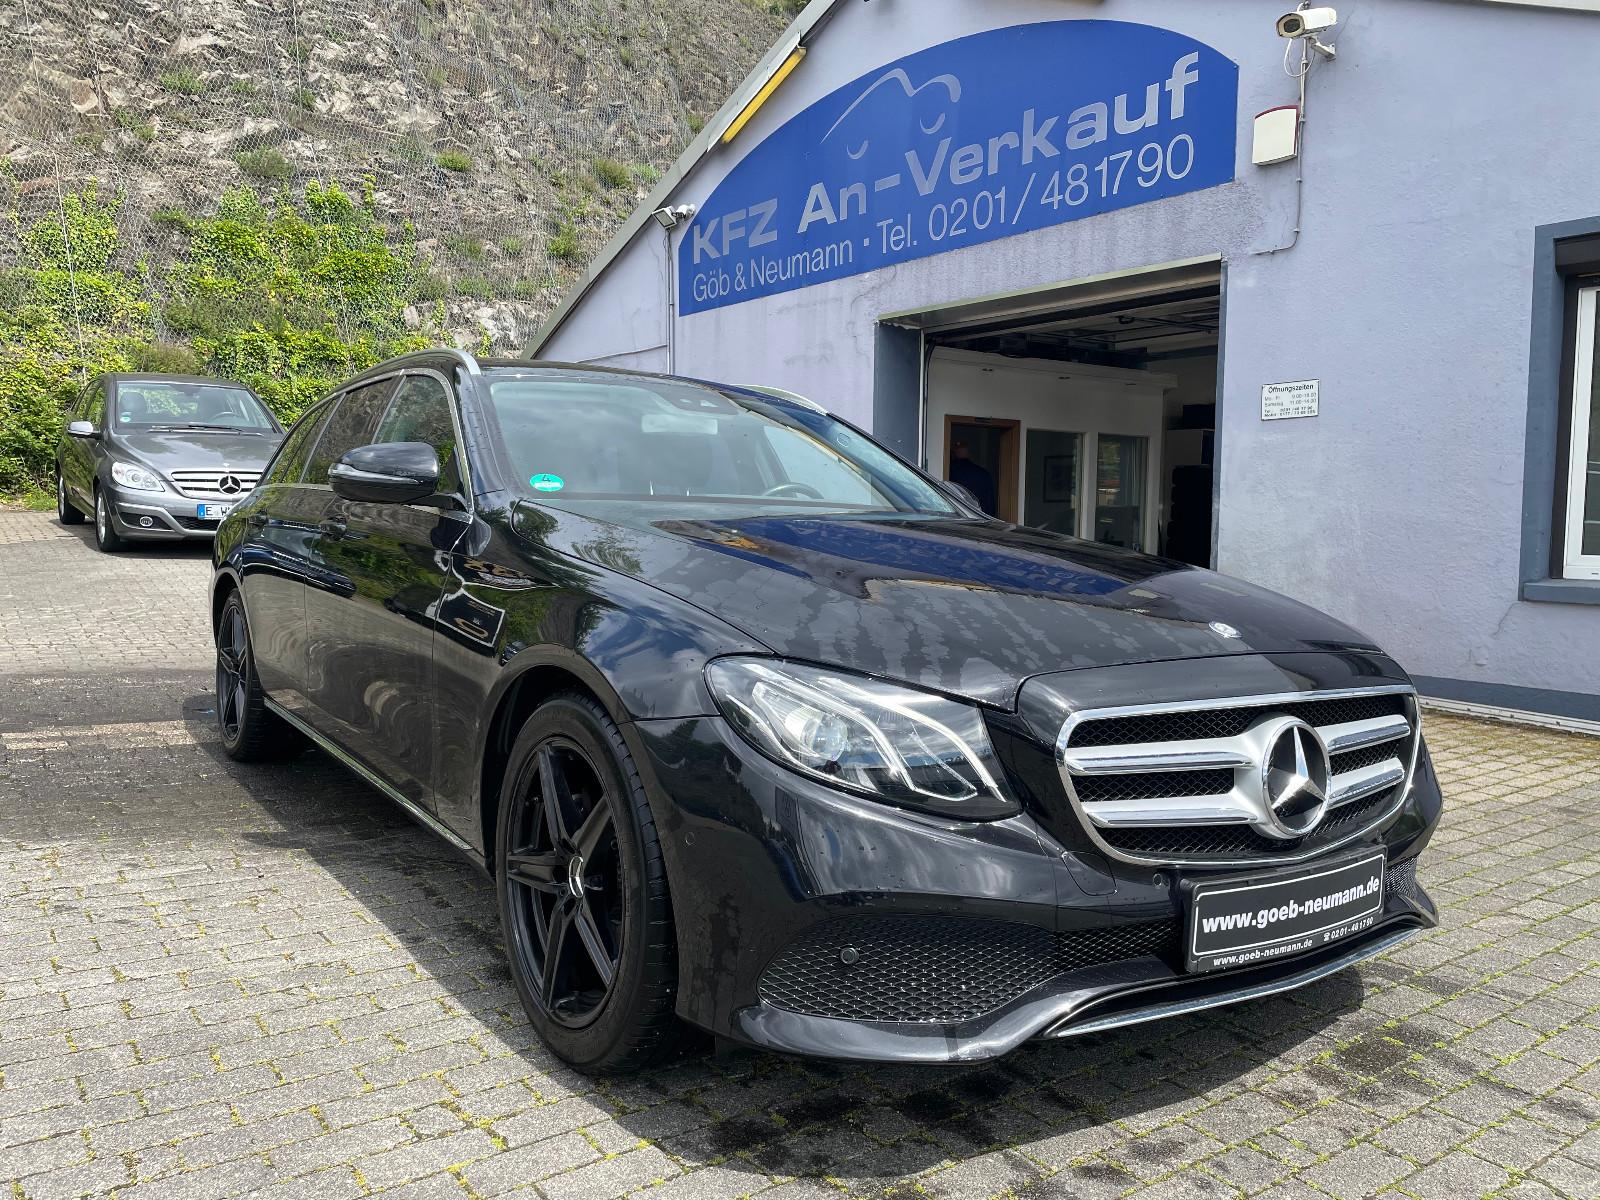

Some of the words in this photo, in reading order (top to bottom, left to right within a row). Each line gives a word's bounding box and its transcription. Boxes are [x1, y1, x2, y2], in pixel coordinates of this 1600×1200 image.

[693, 197, 778, 264] KFZ
[797, 51, 1199, 234] An-Verkauf
[693, 269, 730, 302] Göb
[734, 262, 747, 292] &
[750, 239, 853, 288] Neumann
[876, 213, 918, 254] Tel.
[205, 506, 213, 516] E
[1202, 875, 1380, 933] www.goeb-neumann.de
[1213, 938, 1313, 966] www.goeb-neumann.de
